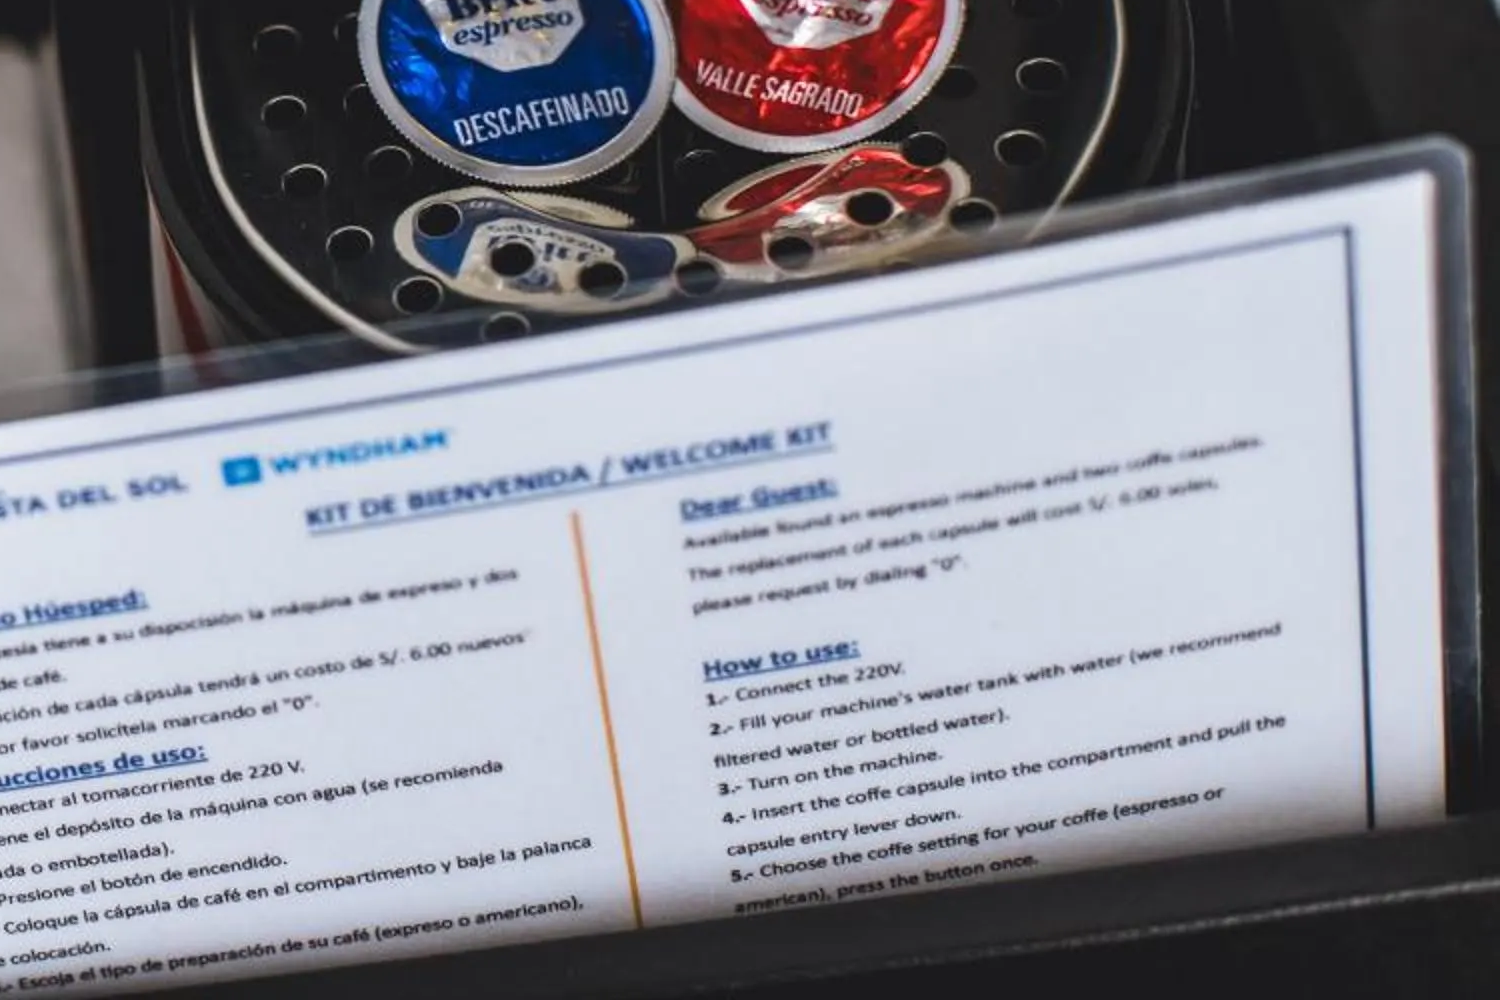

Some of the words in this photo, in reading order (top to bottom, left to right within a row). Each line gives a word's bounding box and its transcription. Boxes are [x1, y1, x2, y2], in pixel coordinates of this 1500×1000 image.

[453, 10, 573, 46] espresso
[695, 58, 761, 98] VALLE
[760, 76, 863, 118] SAGRADO
[453, 87, 630, 146] DESCAFEINADO
[270, 430, 449, 474] WYNDHAM
[304, 506, 351, 527] KIT
[360, 498, 397, 519] DE
[407, 465, 590, 511] BIENVENIDA
[621, 430, 775, 476] WELCOME
[786, 421, 833, 447] KIT
[57, 486, 117, 510] DEL
[127, 476, 189, 497] SOL
[679, 497, 742, 521] Dear
[702, 656, 762, 681] How
[770, 648, 797, 667] to
[805, 640, 860, 661] use:
[709, 722, 734, 737] 2.-
[739, 714, 767, 731] Fill
[771, 709, 814, 729] your
[917, 682, 972, 701] water
[976, 672, 1020, 691] tank
[1022, 664, 1066, 683] with
[1069, 654, 1125, 675] water
[1129, 647, 1164, 665] (we
[1169, 622, 1282, 655] recommend
[46, 701, 70, 716] de
[75, 694, 119, 712] cada
[123, 683, 193, 706] cápsula
[197, 672, 261, 693] tendrá
[265, 670, 290, 684] un
[293, 661, 346, 679] costo
[349, 655, 375, 670] de
[705, 692, 729, 707] 1.-
[735, 677, 813, 702] Connect
[817, 673, 849, 688] the
[21, 734, 70, 751] favor
[162, 705, 257, 729] marcando
[260, 700, 279, 715] el
[713, 745, 782, 769] filtered
[785, 739, 840, 757] water
[845, 734, 867, 748] or
[871, 718, 939, 743] bottled
[942, 707, 1010, 731] water).
[112, 752, 145, 773] de
[151, 745, 207, 767] uso:
[717, 782, 743, 797] 3.-
[747, 775, 790, 791] Turn
[793, 770, 819, 784] on
[822, 763, 855, 779] the
[858, 750, 943, 773] machine.
[721, 811, 747, 825] 4.-
[751, 801, 806, 821] Insert
[809, 796, 841, 811] the
[845, 785, 892, 805] coffe
[895, 774, 966, 797] capsule
[970, 768, 1008, 783] into
[1011, 762, 1043, 776] the
[1047, 736, 1173, 771] compartment
[1177, 727, 1213, 747] and
[1216, 719, 1252, 741] pull
[1255, 716, 1286, 732] the
[33, 826, 51, 841] el
[55, 817, 135, 838] depósito
[139, 811, 164, 826] de
[166, 808, 184, 822] la
[189, 797, 269, 819] máquina
[273, 791, 308, 806] con
[311, 784, 357, 803] agua
[361, 778, 389, 796] (se
[393, 760, 504, 789] recomienda
[61, 792, 78, 807] al
[81, 775, 216, 804] tomacorriente
[220, 768, 243, 784] de
[248, 762, 284, 780] 220
[726, 834, 796, 857] capsule
[799, 827, 849, 845] entry
[853, 819, 900, 836] lever
[904, 810, 962, 828] down.
[730, 869, 754, 883] 5.-
[759, 857, 828, 878] Choose
[831, 851, 863, 867] the
[867, 842, 914, 861] coffe
[918, 832, 980, 853] setting
[983, 827, 1010, 841] for
[1014, 819, 1058, 838] your
[1061, 808, 1109, 827] coffe
[1112, 793, 1200, 821] (espresso
[1203, 787, 1225, 801] or
[30, 863, 44, 875] o
[47, 841, 175, 872] embotellada).
[79, 879, 97, 895] el
[99, 872, 156, 891] botón
[160, 868, 183, 883] de
[187, 853, 288, 879] encendido.
[836, 880, 885, 900] press
[889, 874, 920, 889] the
[923, 863, 985, 883] button
[989, 855, 1039, 872] once.
[3, 914, 79, 935] Coloque
[82, 909, 99, 924] la
[103, 899, 172, 920] cápsula
[176, 895, 200, 911] de
[203, 888, 242, 906] café
[245, 887, 269, 901] en
[273, 881, 291, 897] el
[294, 863, 437, 894] compartimento
[440, 860, 452, 874] y
[455, 852, 496, 869] baje
[499, 848, 517, 862] la
[521, 837, 592, 862] palanca
[9, 941, 111, 965] colocación.
[17, 972, 75, 990] Escoja
[79, 967, 97, 982] el
[99, 964, 137, 980] tipo
[140, 958, 164, 973] de
[167, 943, 277, 972] preparación
[280, 939, 304, 953] de
[307, 937, 329, 950] su
[332, 928, 371, 946] café
[374, 919, 454, 942] (expreso
[457, 916, 471, 927] o
